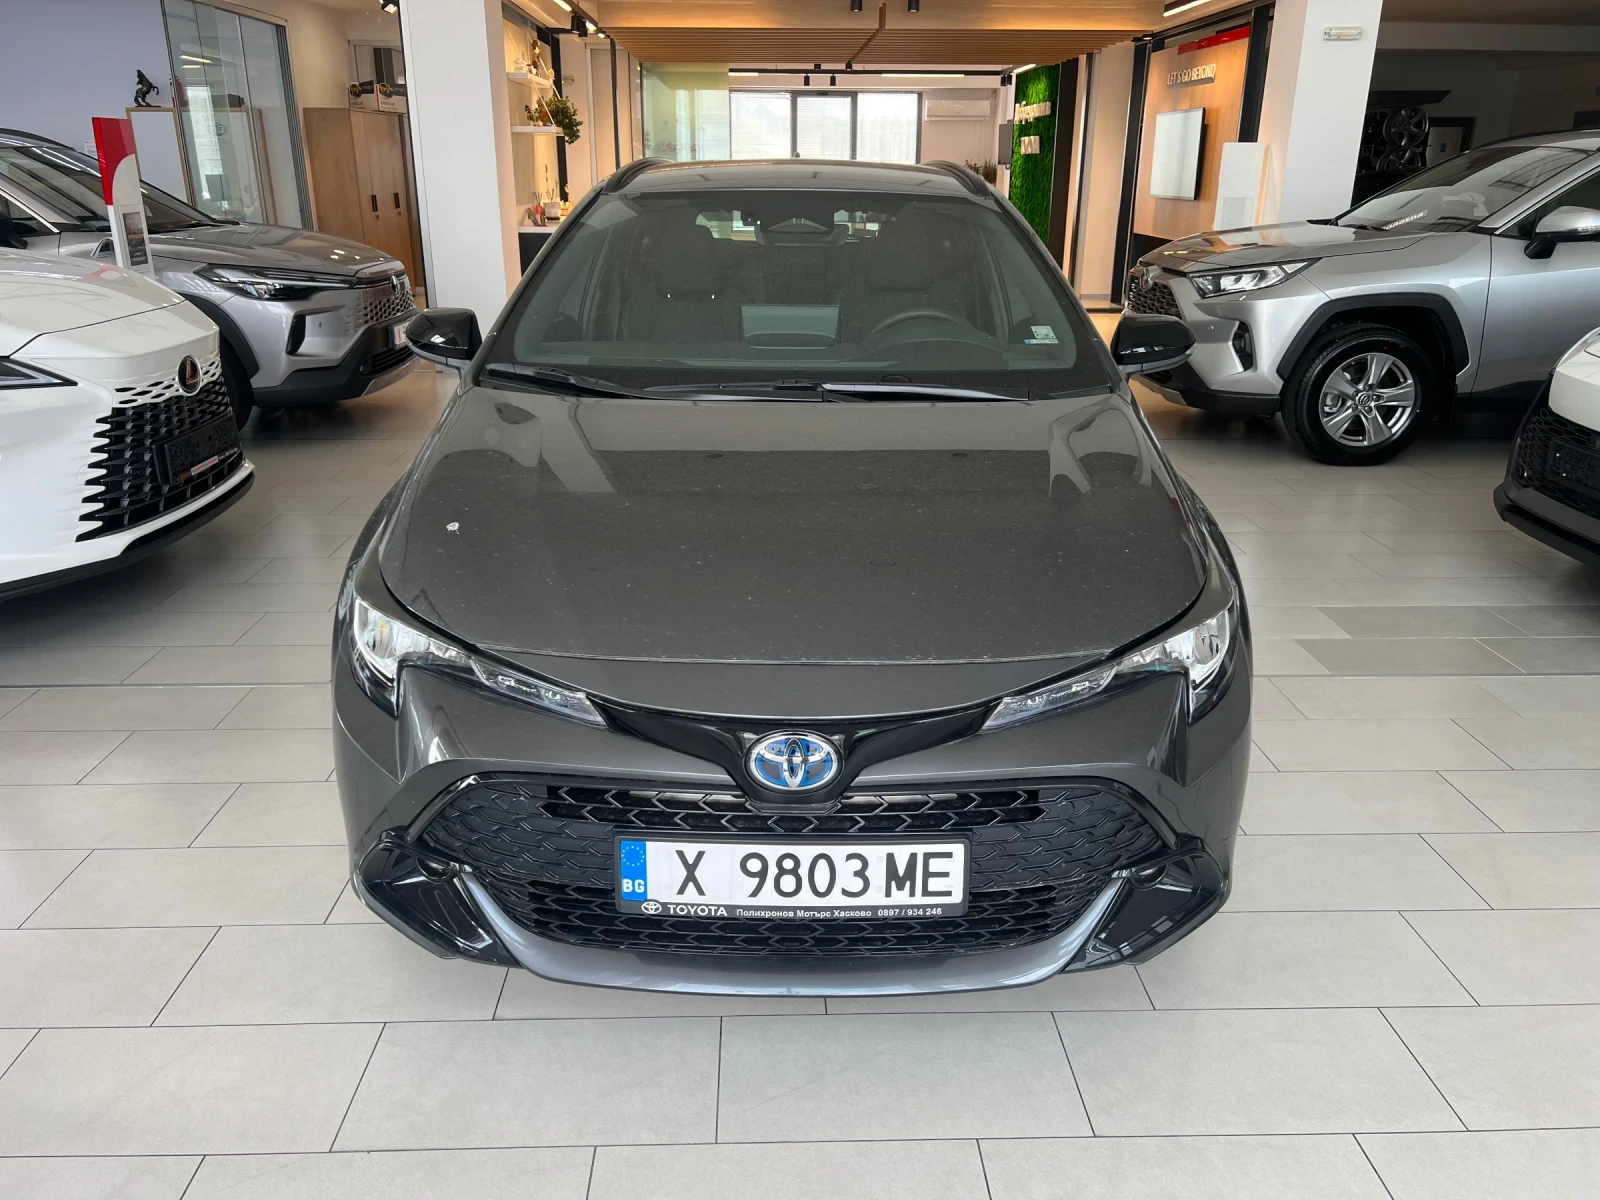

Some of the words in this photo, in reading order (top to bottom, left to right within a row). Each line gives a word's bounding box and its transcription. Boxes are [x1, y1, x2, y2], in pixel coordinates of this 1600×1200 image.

[1181, 69, 1192, 82] GO
[1191, 63, 1216, 80] BEYOND
[675, 849, 707, 896] X
[739, 852, 871, 898] 9803
[884, 851, 953, 898] ME
[622, 879, 645, 893] BG
[667, 904, 728, 917] TOYOTA
[736, 908, 794, 918] Полихронов
[797, 909, 831, 918] Мотърс
[833, 909, 872, 917] Хасково
[877, 908, 899, 916] 0897
[907, 908, 923, 916] 934
[925, 907, 942, 916] 246
